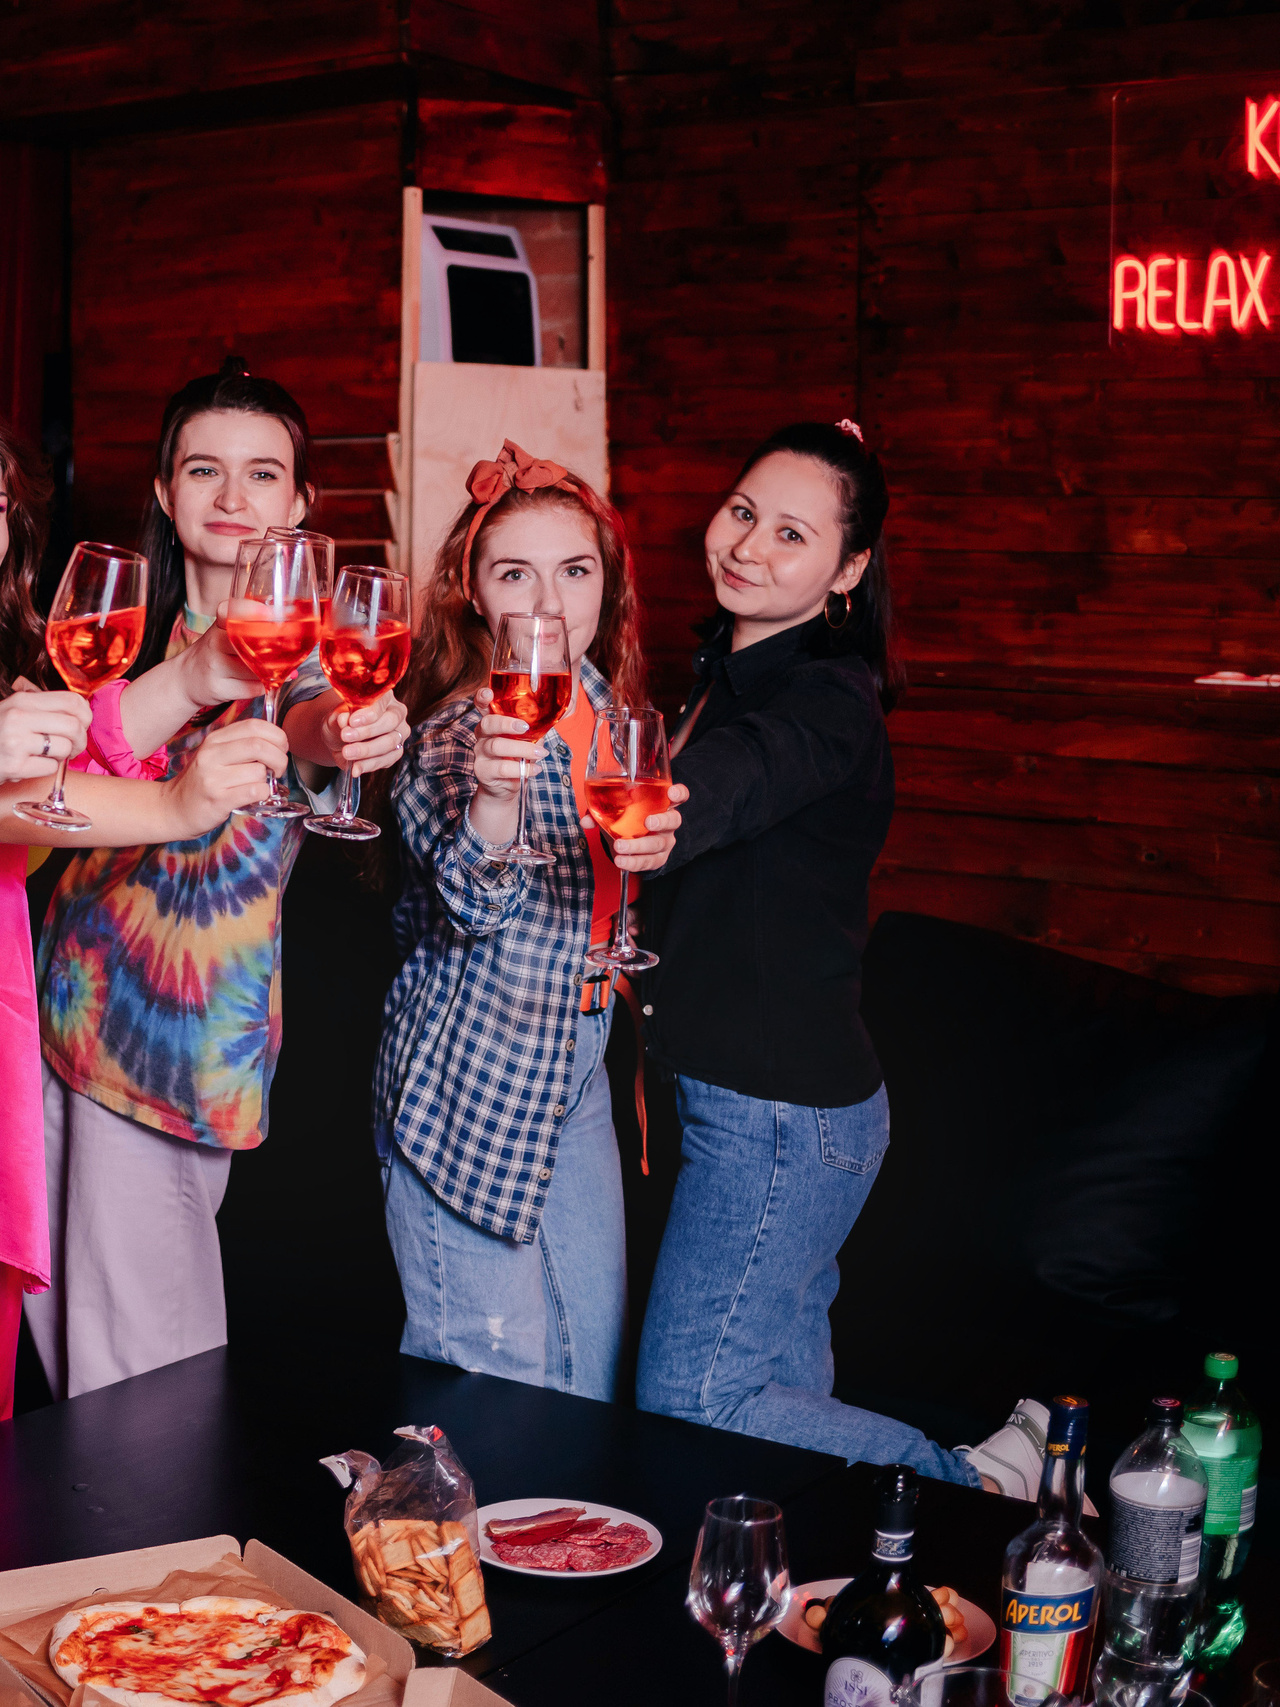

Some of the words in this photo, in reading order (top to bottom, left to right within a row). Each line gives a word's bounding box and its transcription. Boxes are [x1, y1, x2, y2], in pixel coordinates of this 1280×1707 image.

[1246, 98, 1280, 177] K
[1113, 252, 1271, 332] RELAX
[1005, 1598, 1082, 1626] APEROL
[1019, 1649, 1055, 1658] APERITIVO
[828, 1692, 861, 1707] PROS
